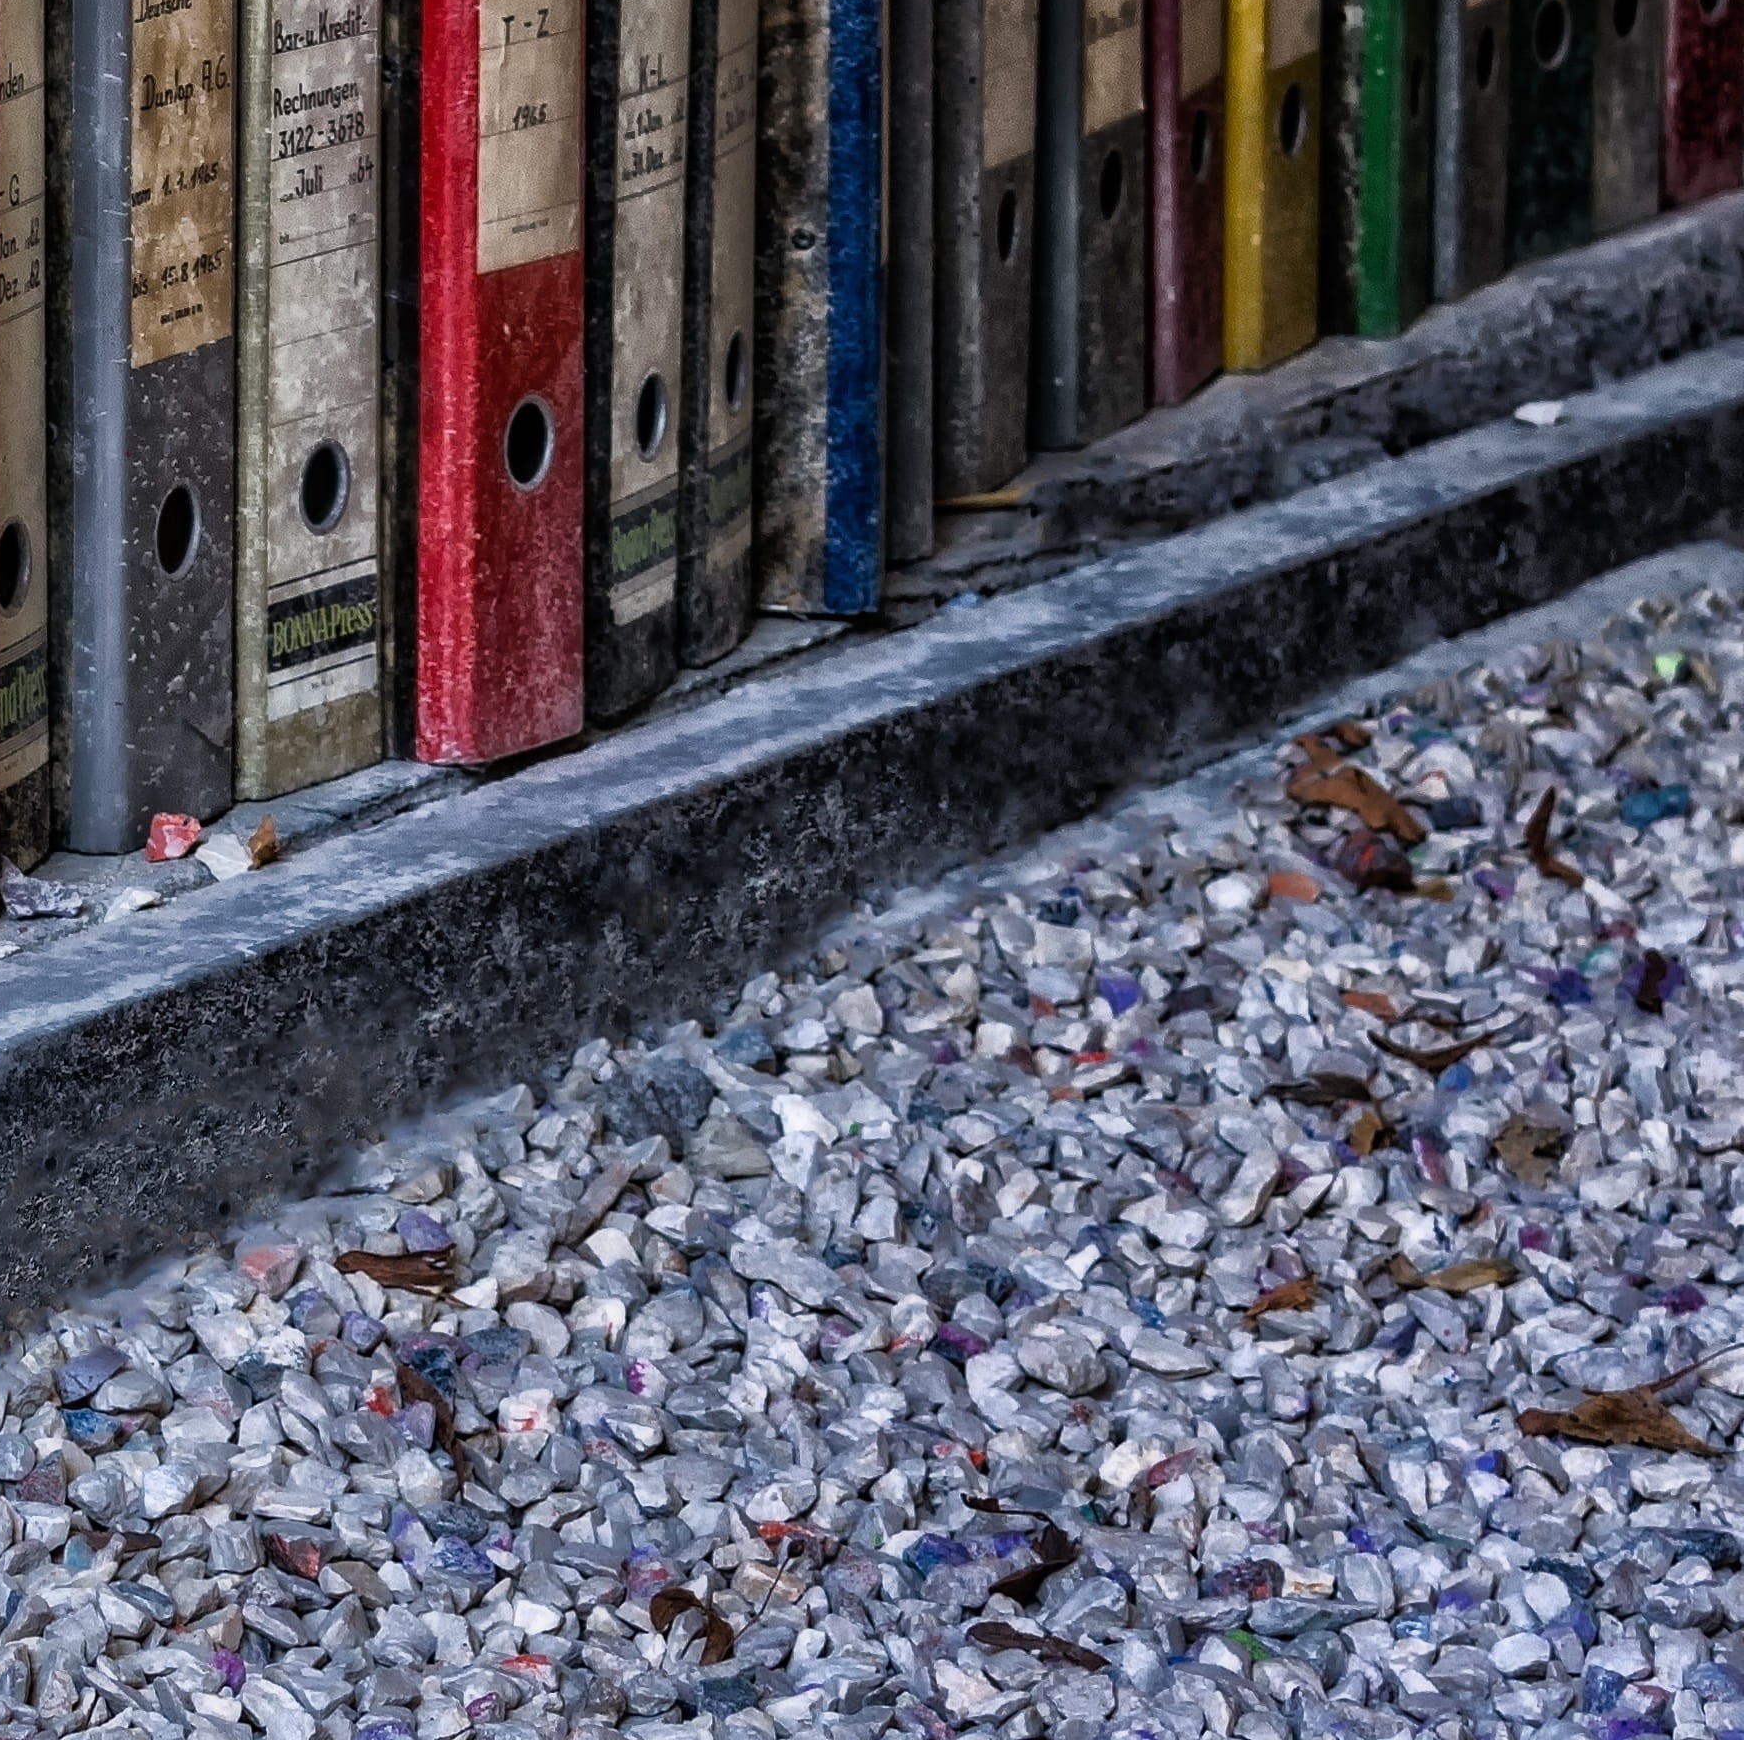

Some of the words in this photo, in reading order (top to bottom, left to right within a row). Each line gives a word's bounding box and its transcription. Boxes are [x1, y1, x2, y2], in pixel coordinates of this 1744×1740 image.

[536, 8, 551, 39] Z
[141, 68, 194, 115] Dunlop
[273, 81, 360, 119] Rechnungen
[278, 122, 315, 159] 3122
[8, 173, 21, 207] G
[295, 164, 324, 200] Juli
